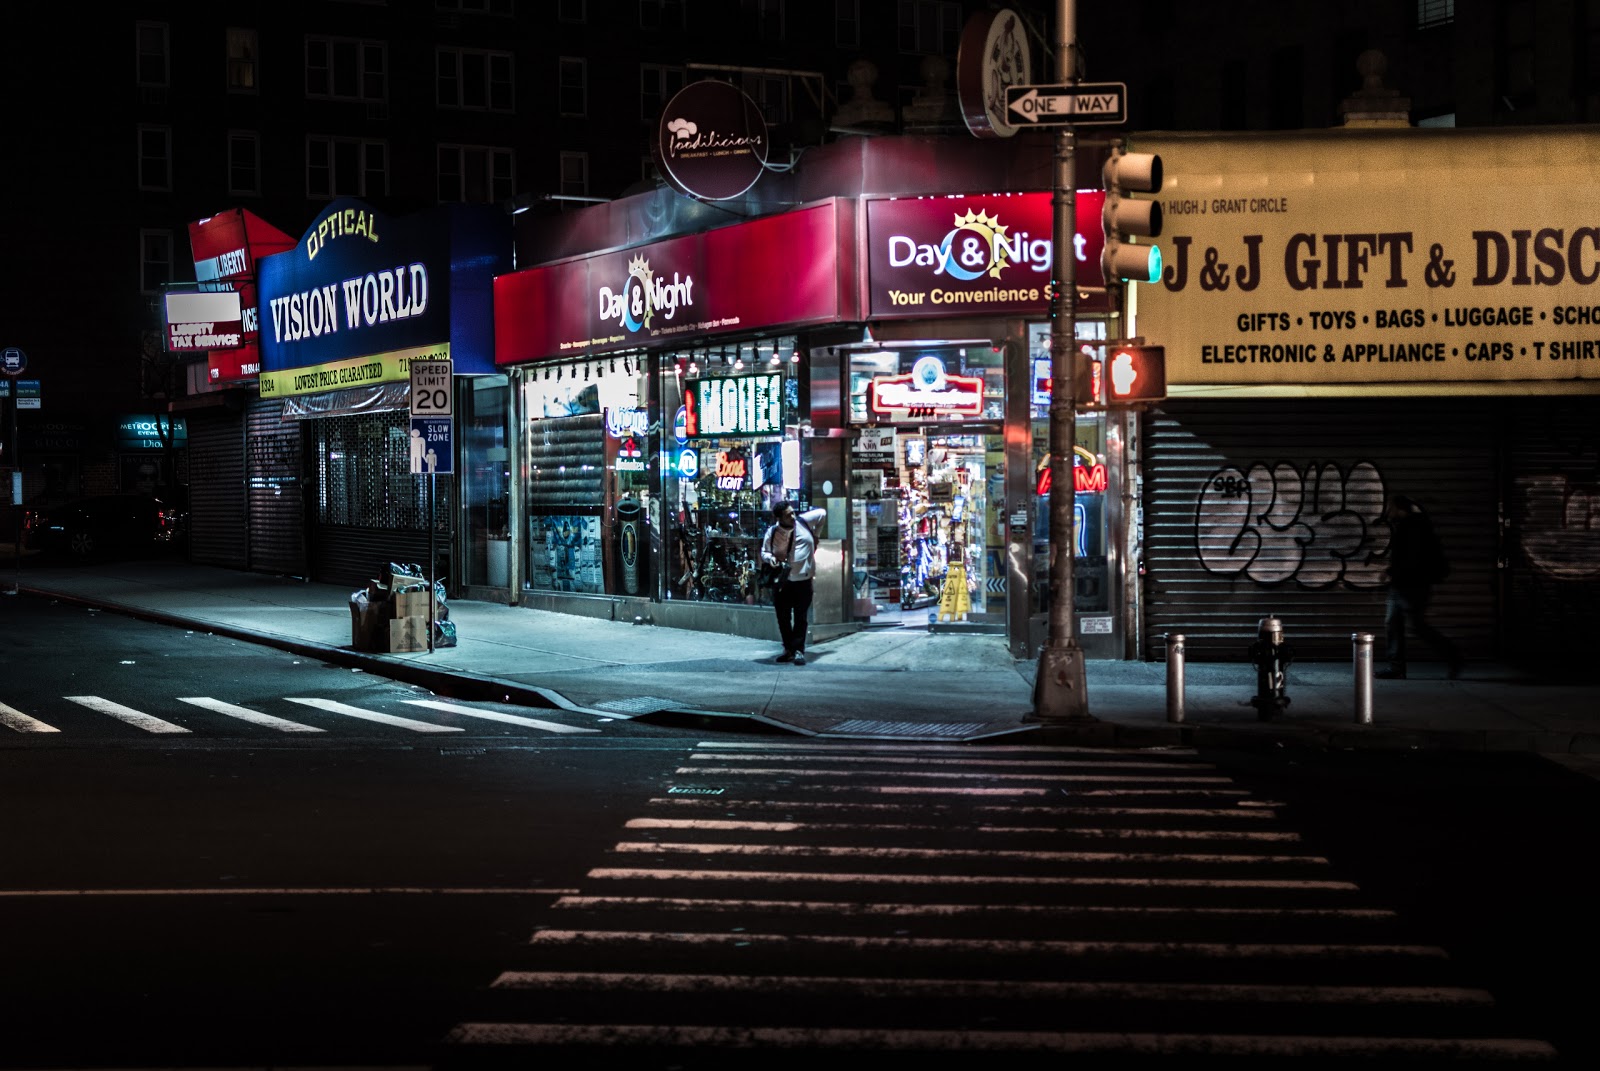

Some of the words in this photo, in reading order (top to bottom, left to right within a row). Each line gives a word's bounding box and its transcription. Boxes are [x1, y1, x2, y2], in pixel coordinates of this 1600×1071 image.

[1022, 98, 1057, 113] ONE
[1076, 96, 1114, 111] WAY
[1169, 200, 1199, 215] HUGH
[1201, 200, 1207, 214] J
[1212, 199, 1247, 214] GRANT
[1249, 197, 1288, 213] CIRCLE
[307, 209, 379, 261] OPTICAL
[216, 248, 247, 279] LIBERTY
[889, 235, 953, 275] Day
[960, 237, 984, 267] &
[993, 232, 1087, 272] Nigt
[1163, 236, 1193, 292] J
[1199, 246, 1230, 292] &
[1235, 234, 1264, 292] J
[1284, 231, 1414, 291] GIFT
[1424, 242, 1456, 288] &
[1472, 226, 1600, 286] DISC
[269, 284, 338, 343] VISION
[342, 263, 428, 329] WORLD
[600, 286, 629, 328] Day
[631, 284, 643, 317] &
[645, 271, 693, 320] Night
[888, 290, 926, 306] Your
[930, 286, 1040, 305] Convenience
[171, 322, 214, 336] LIBERTY
[1237, 312, 1291, 332] GIFTS
[1309, 310, 1356, 330] TOYS
[1375, 309, 1426, 328] BAGS
[1444, 306, 1534, 327] LUGGAGE
[171, 336, 193, 348] TAX
[194, 334, 239, 347] SERVICE
[1201, 344, 1317, 364] ELECTRONIC
[1322, 344, 1336, 363] &
[1341, 343, 1446, 363] APPLIANCE
[1464, 342, 1514, 361] CAPS
[1532, 342, 1545, 360] T
[294, 372, 319, 390] LOWEST
[320, 368, 338, 387] PRICE
[340, 363, 383, 383] GUARANTEED
[414, 365, 448, 375] SPEED
[417, 376, 446, 386] LIMIT
[416, 389, 448, 409] 20
[427, 425, 449, 434] SLOW
[427, 434, 449, 442] ZONE
[717, 476, 744, 491] LIGHT
